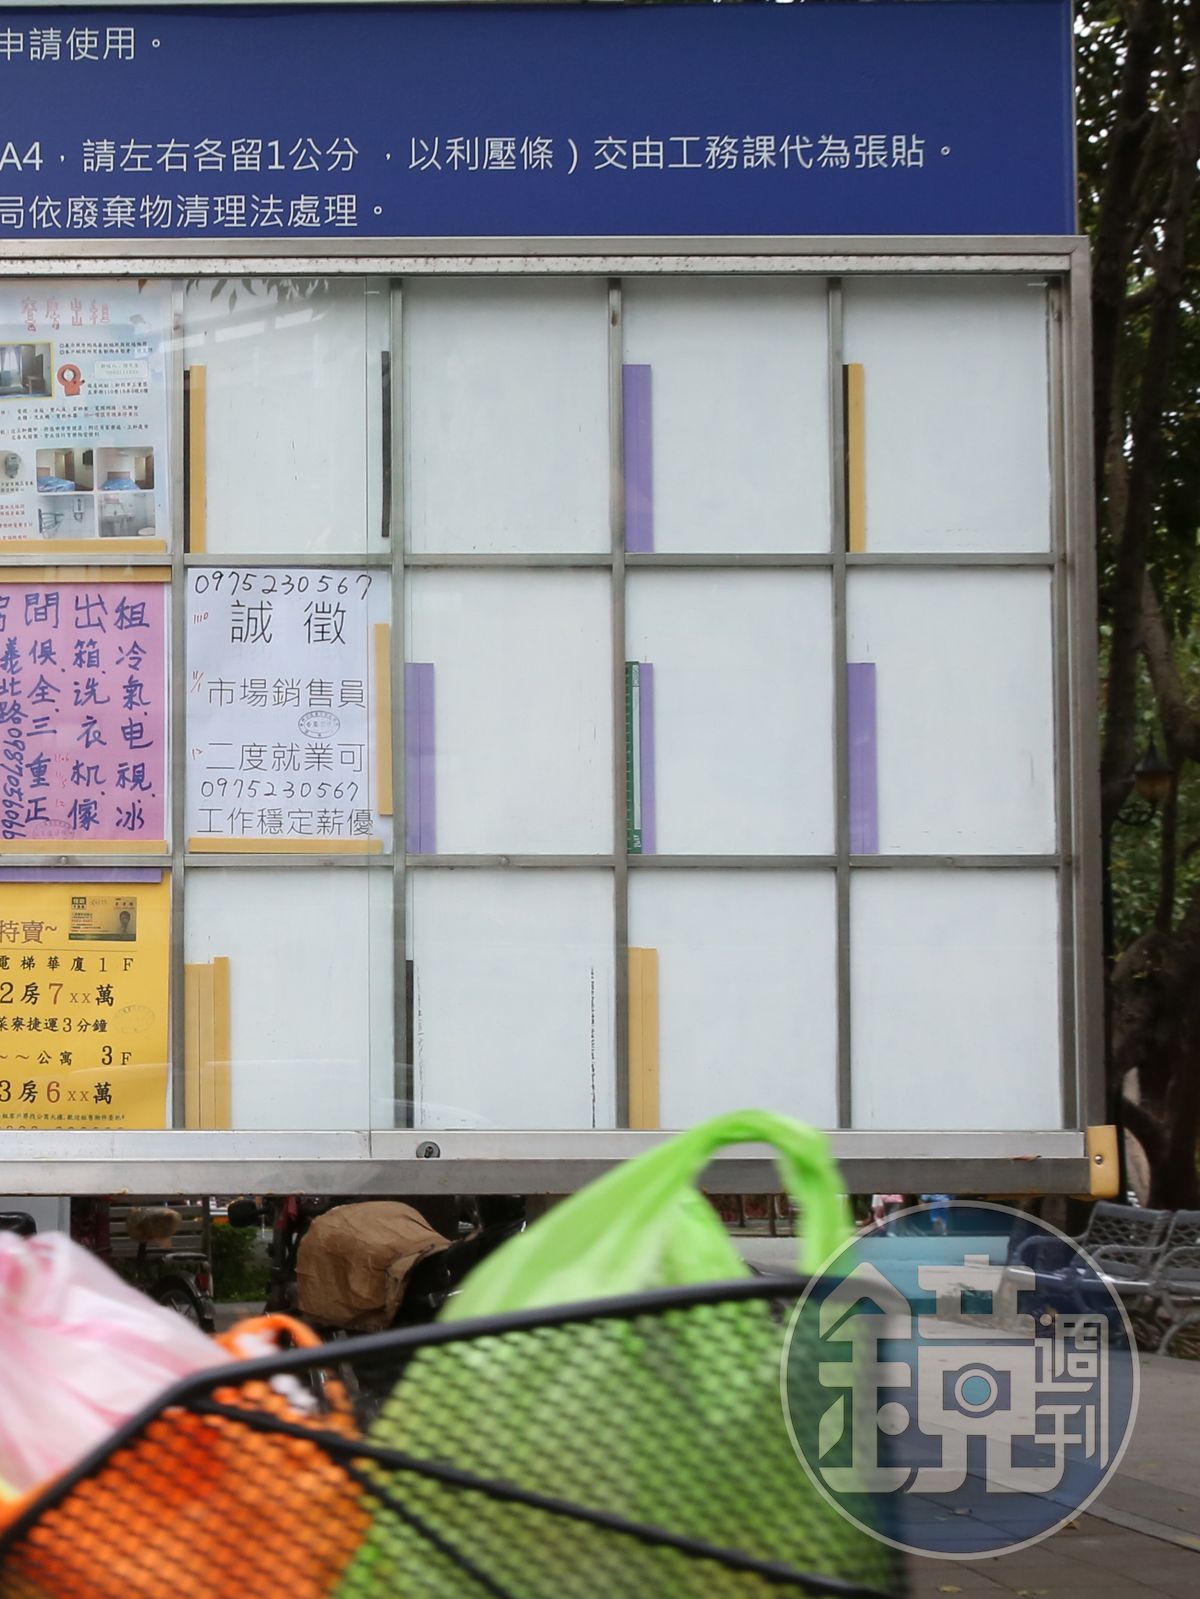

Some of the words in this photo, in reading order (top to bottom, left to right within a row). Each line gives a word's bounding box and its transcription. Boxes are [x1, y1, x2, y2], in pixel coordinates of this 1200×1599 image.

[195, 570, 372, 600] 0975230567
[230, 599, 346, 644] 誠徵
[207, 678, 366, 708] 市場銷售員
[206, 742, 365, 773] 二度就業可
[201, 777, 359, 801] 0975230567
[197, 807, 374, 836] 工作穩定薪優
